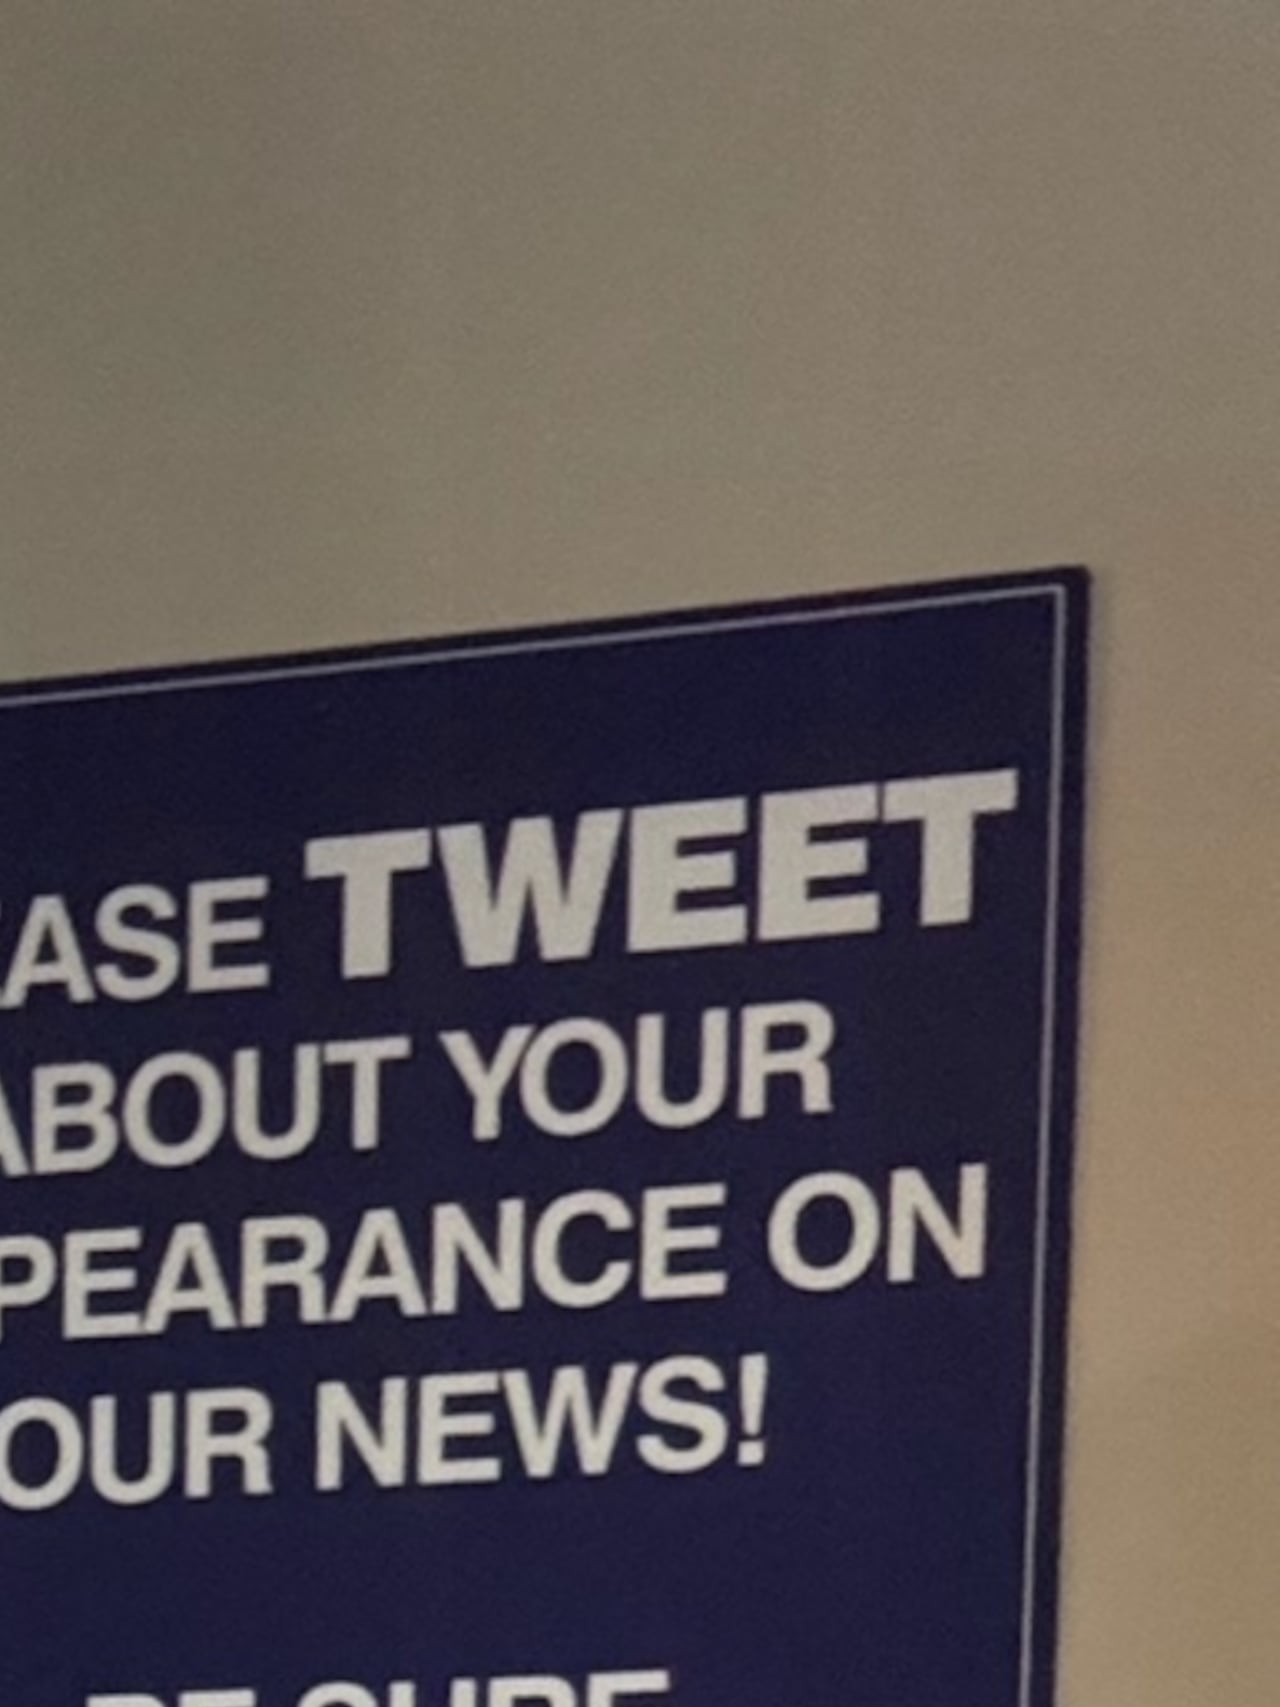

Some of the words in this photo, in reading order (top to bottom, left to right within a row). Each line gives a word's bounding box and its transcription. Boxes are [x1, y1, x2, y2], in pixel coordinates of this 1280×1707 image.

[305, 769, 1018, 977] TWEET
[439, 1001, 834, 1139] YOUR
[767, 1163, 987, 1292] ON
[316, 1353, 769, 1491] NEWS!
